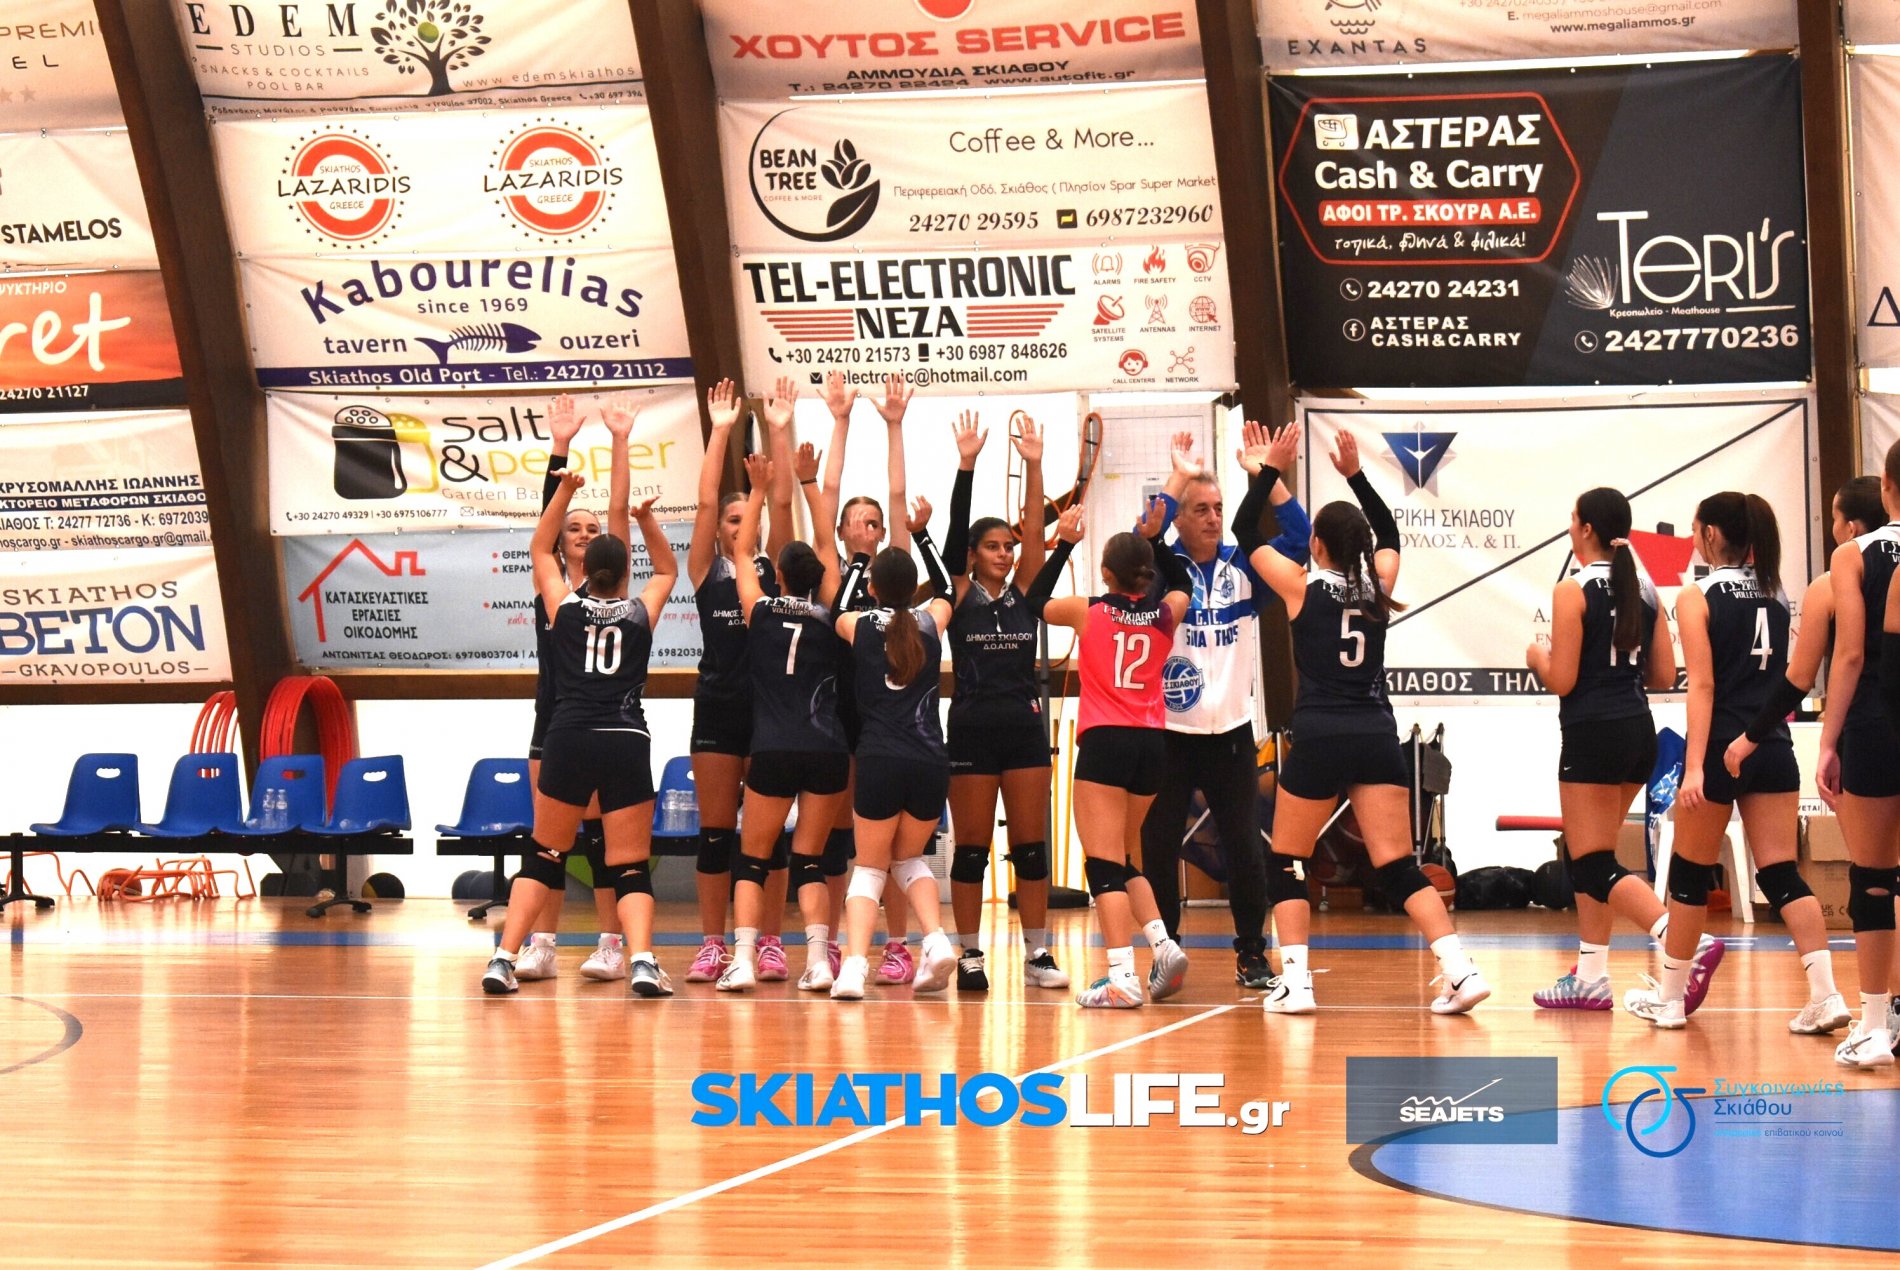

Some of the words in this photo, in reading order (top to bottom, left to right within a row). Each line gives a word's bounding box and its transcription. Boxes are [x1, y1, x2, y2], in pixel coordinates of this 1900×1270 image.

[186, 2, 359, 37] EDEM
[1550, 15, 1696, 33] www.megaliammos.gr
[730, 31, 938, 59] ΧΟΥΤΟΣ
[955, 12, 1185, 54] SERVICE
[230, 44, 326, 57] STUDIOS
[1288, 38, 1427, 56] EXANTAS
[200, 64, 259, 76] SNACKS
[279, 67, 369, 77] COCKTAILS
[846, 67, 965, 81] ΑΜΜΟΥΔΙΑ
[972, 60, 1070, 77] ΣΚΙΑΘΟΥ
[984, 69, 1136, 85] www.autofit.gr
[247, 81, 287, 90] POOL
[295, 82, 324, 91] BAR
[949, 128, 1035, 153] Coffee
[1045, 128, 1063, 150] &
[1073, 128, 1155, 148] More...
[1363, 113, 1541, 150] ΑΣΤΕΡΑΣ
[529, 157, 573, 167] SKIATHOS
[760, 149, 816, 168] BEAN
[319, 165, 361, 174] SKIATHOS
[1314, 161, 1398, 189] Cash
[1408, 161, 1438, 189] &
[1446, 160, 1543, 193] Carry
[277, 176, 411, 198] LAZARIDIS
[484, 167, 623, 193] LAZARIDIS
[764, 172, 817, 191] TREE
[1109, 179, 1136, 192] Spar
[1140, 177, 1173, 191] Super
[1177, 174, 1217, 188] Market
[330, 200, 364, 210] GREECE
[537, 193, 573, 204] GREECE
[909, 213, 970, 232] 24270
[976, 211, 1039, 231] 29595
[1086, 204, 1214, 228] 6987232960
[1323, 204, 1372, 222] ΑΦΟΙ
[1413, 202, 1494, 221] ΣΚΟΥΡΑ
[1, 217, 122, 244] STAMELOS
[1453, 231, 1466, 248] &
[743, 254, 1076, 304] TEL-ELECTRONIC
[300, 256, 643, 324] Kabourelias
[1367, 280, 1440, 299] 24270
[1448, 279, 1520, 298] 24231
[417, 300, 470, 314] since
[480, 297, 528, 313] 1969
[1671, 305, 1721, 317] Meathouse
[855, 306, 965, 339] NEZA
[1370, 316, 1469, 331] ΑΣΤΕΡΑΣ
[323, 336, 408, 354] tavern
[559, 328, 641, 350] ouzeri
[1371, 332, 1521, 348] CASH&CARRY
[1604, 324, 1799, 352] 2427770236
[785, 349, 812, 363] +30
[816, 348, 861, 364] 24270
[866, 346, 911, 362] 21573
[936, 345, 964, 360] +30
[969, 344, 1006, 360] 6987
[1011, 342, 1068, 359] 848626
[308, 370, 393, 385] Skiathos
[399, 368, 433, 383] Old
[439, 367, 482, 383] Port
[501, 366, 539, 381] Tel.:
[543, 364, 605, 380] 24270
[612, 362, 668, 378] 21112
[47, 385, 89, 399] 21127
[441, 406, 550, 443] salt
[439, 444, 489, 483] &
[123, 474, 200, 490] ΙΩΑΝΝΗΣ
[62, 494, 150, 509] ΜΕΤΑΦΟΡΩΝ
[441, 487, 508, 501] Garden
[0, 516, 41, 531] ΙΑΘΟΣ
[58, 514, 90, 530] 24277
[96, 512, 131, 528] 72736
[159, 509, 209, 525] 6972039
[293, 512, 310, 521] +30
[312, 511, 340, 521] 24270
[342, 510, 369, 520] 49329
[394, 508, 448, 520] 6975106777
[1441, 509, 1516, 528] ΣΚΙΑΘΟΥ
[1486, 534, 1498, 550] &
[3, 581, 178, 606] SKIATHOS
[325, 590, 429, 606] ΚΑΤΑΣΚΕΥΑΣΤΙΚΕΣ
[352, 608, 402, 623] ΕΡΓΑΣΙΕΣ
[0, 604, 206, 656] BETON
[343, 625, 419, 640] ΟΙΚΟΔΟΜΗΣ
[966, 633, 997, 643] ΔΗΜΟΣ
[999, 632, 1033, 642] ΣΚΙΑΘΟΥ
[1339, 608, 1365, 668] 5
[1750, 607, 1773, 671] 4
[322, 650, 386, 660] ΑΝΤΩΝΙΤΣΑΣ
[388, 650, 451, 660] ΘΕΟΔΩΡΟΣ:
[455, 650, 519, 660] 6970803704
[584, 624, 623, 675] 10
[782, 621, 803, 676] 7
[19, 661, 191, 677] GKAVOPOULOS
[1112, 631, 1151, 690] 12
[1488, 671, 1547, 692] ΤΗΛ.
